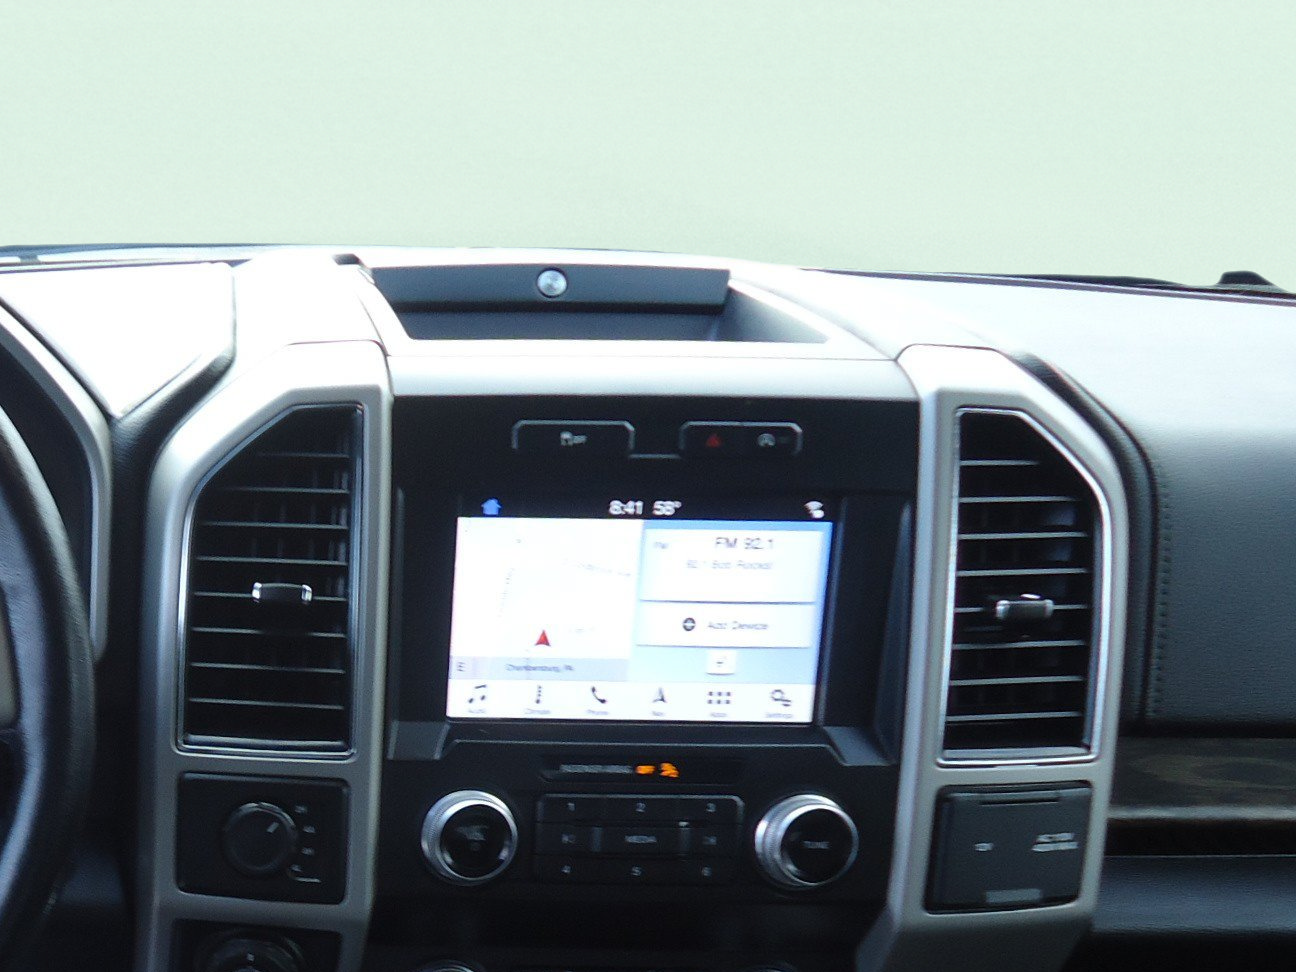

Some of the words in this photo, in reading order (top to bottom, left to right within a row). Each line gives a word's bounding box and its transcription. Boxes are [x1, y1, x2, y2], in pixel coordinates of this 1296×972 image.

[608, 500, 644, 515] 8:41
[715, 537, 738, 549] FM
[744, 537, 774, 549] 92.1
